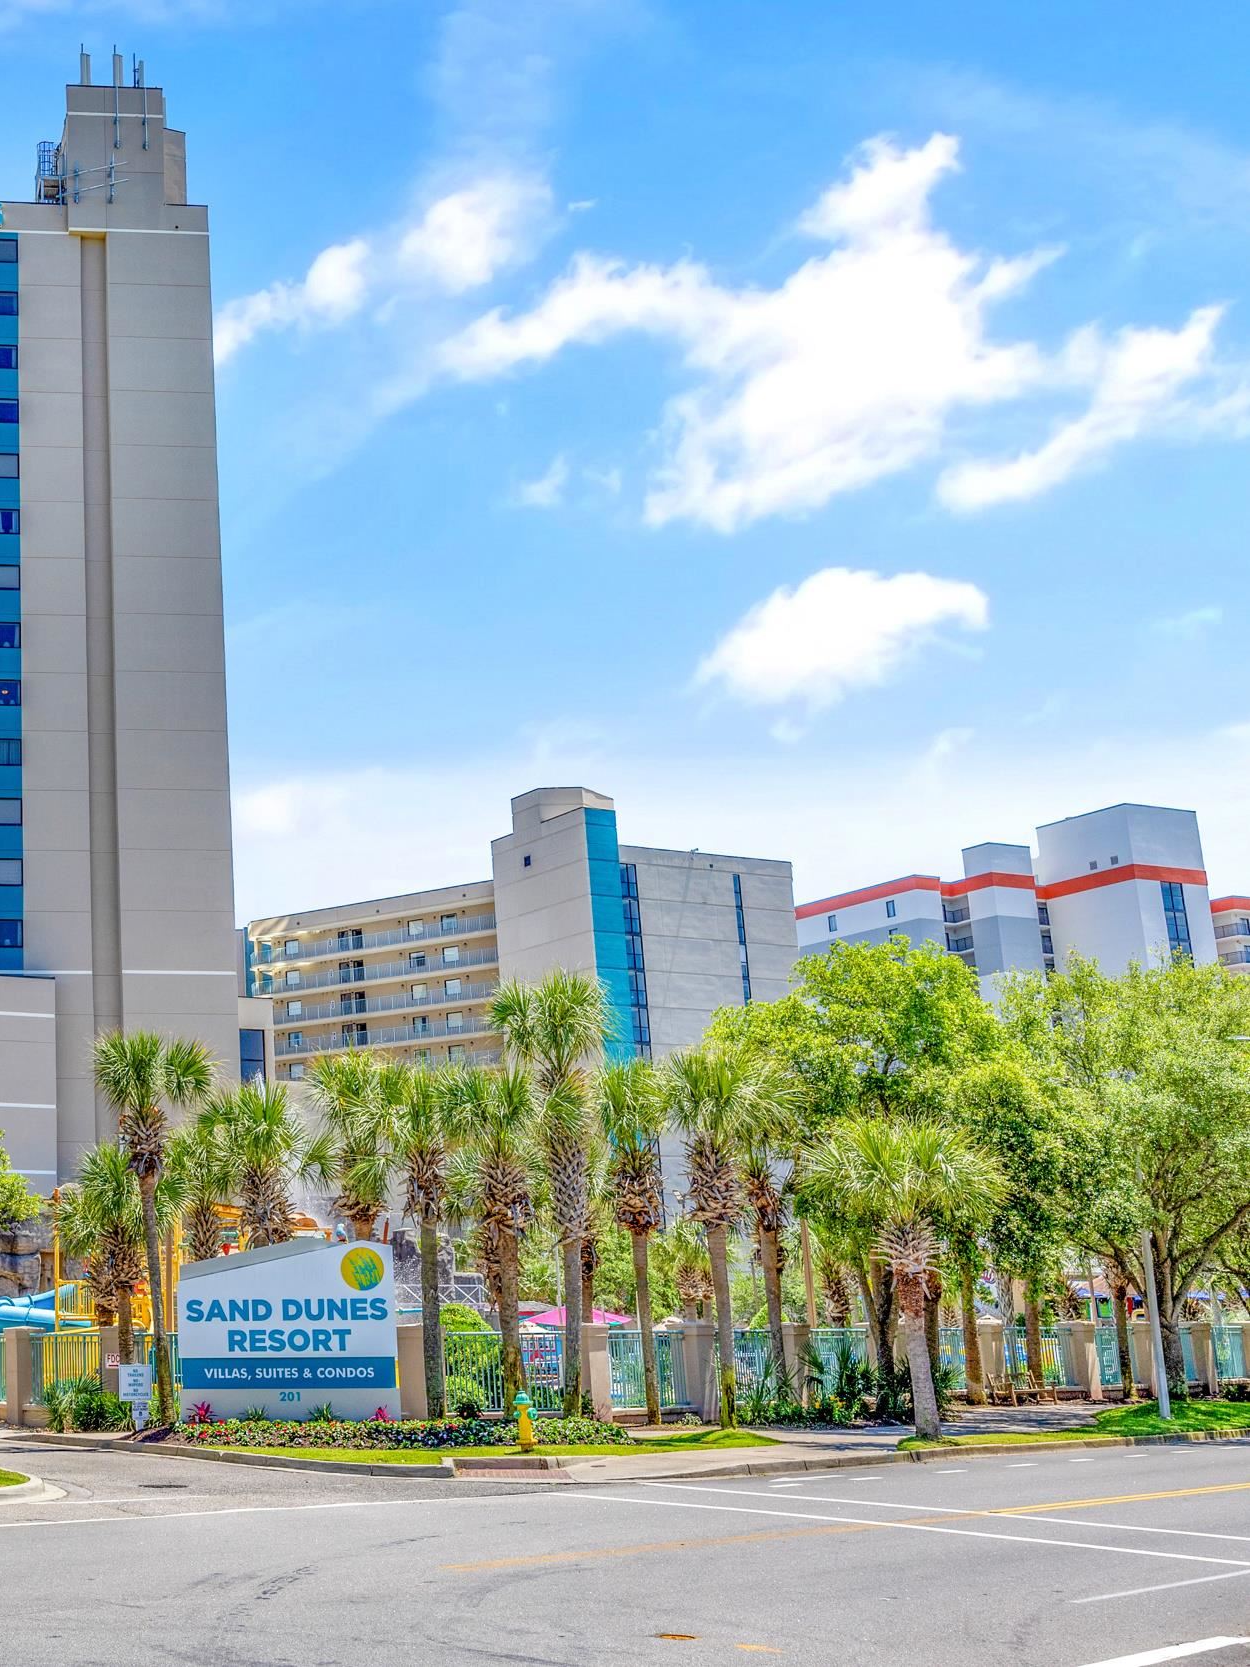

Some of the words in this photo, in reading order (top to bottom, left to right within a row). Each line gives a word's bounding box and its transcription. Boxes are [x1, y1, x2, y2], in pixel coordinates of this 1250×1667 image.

[185, 1299, 273, 1322] SAND
[282, 1298, 388, 1321] DUNES
[228, 1328, 352, 1352] RESORT
[204, 1368, 251, 1380] VILLAS,
[255, 1368, 299, 1379] SUITES
[302, 1368, 312, 1378] &
[317, 1367, 375, 1378] CONDOS
[279, 1391, 301, 1402] 201
